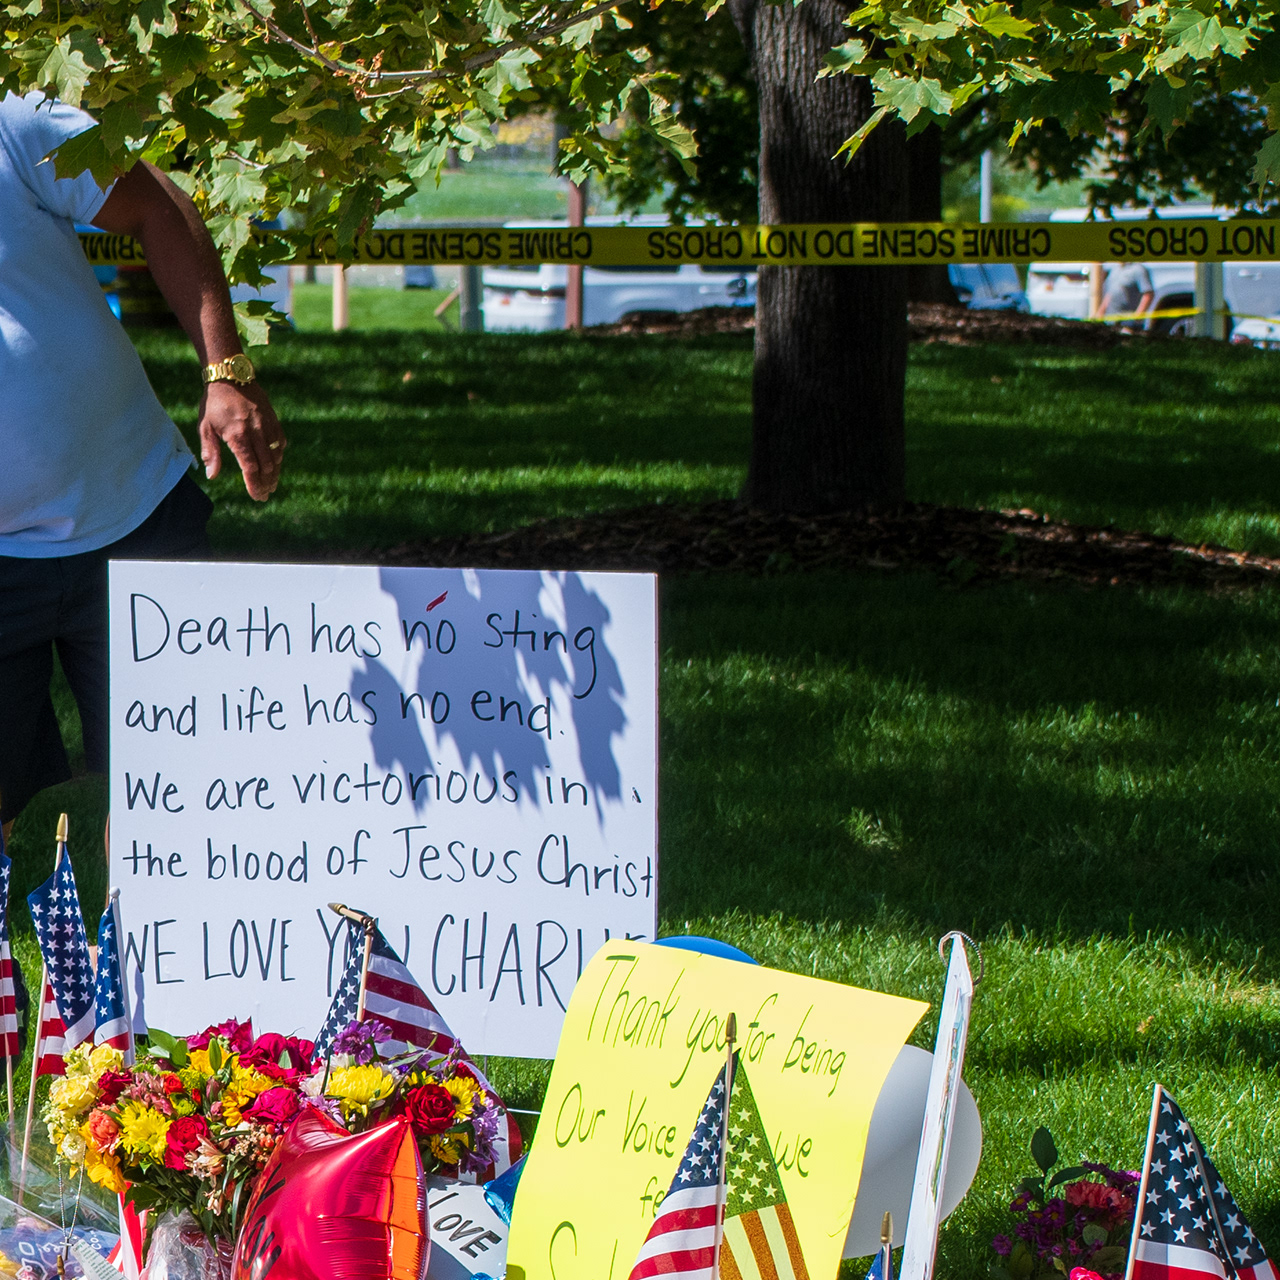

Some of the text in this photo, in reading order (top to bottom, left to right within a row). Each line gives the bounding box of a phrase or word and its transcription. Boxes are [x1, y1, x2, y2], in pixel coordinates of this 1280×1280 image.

[365, 233, 406, 260] DO
[412, 232, 502, 260] SCENE
[508, 231, 593, 260] CRIME
[647, 228, 1051, 261] CRIME SCENE DO NOT CROSS
[1108, 225, 1275, 257] NOT CROSS
[129, 591, 292, 663] Death
[309, 602, 382, 660] has
[402, 616, 457, 656] no
[124, 683, 566, 739] and life has no end.
[124, 770, 186, 814] We
[204, 773, 276, 812] are
[292, 760, 520, 807] victorious
[122, 825, 654, 900] the blood of Jesus Christ
[124, 918, 186, 986] WE
[201, 916, 297, 983] LOVE
[586, 954, 848, 1098] Thank you for being
[554, 1082, 606, 1149] Our
[621, 1090, 678, 1158] Voice
